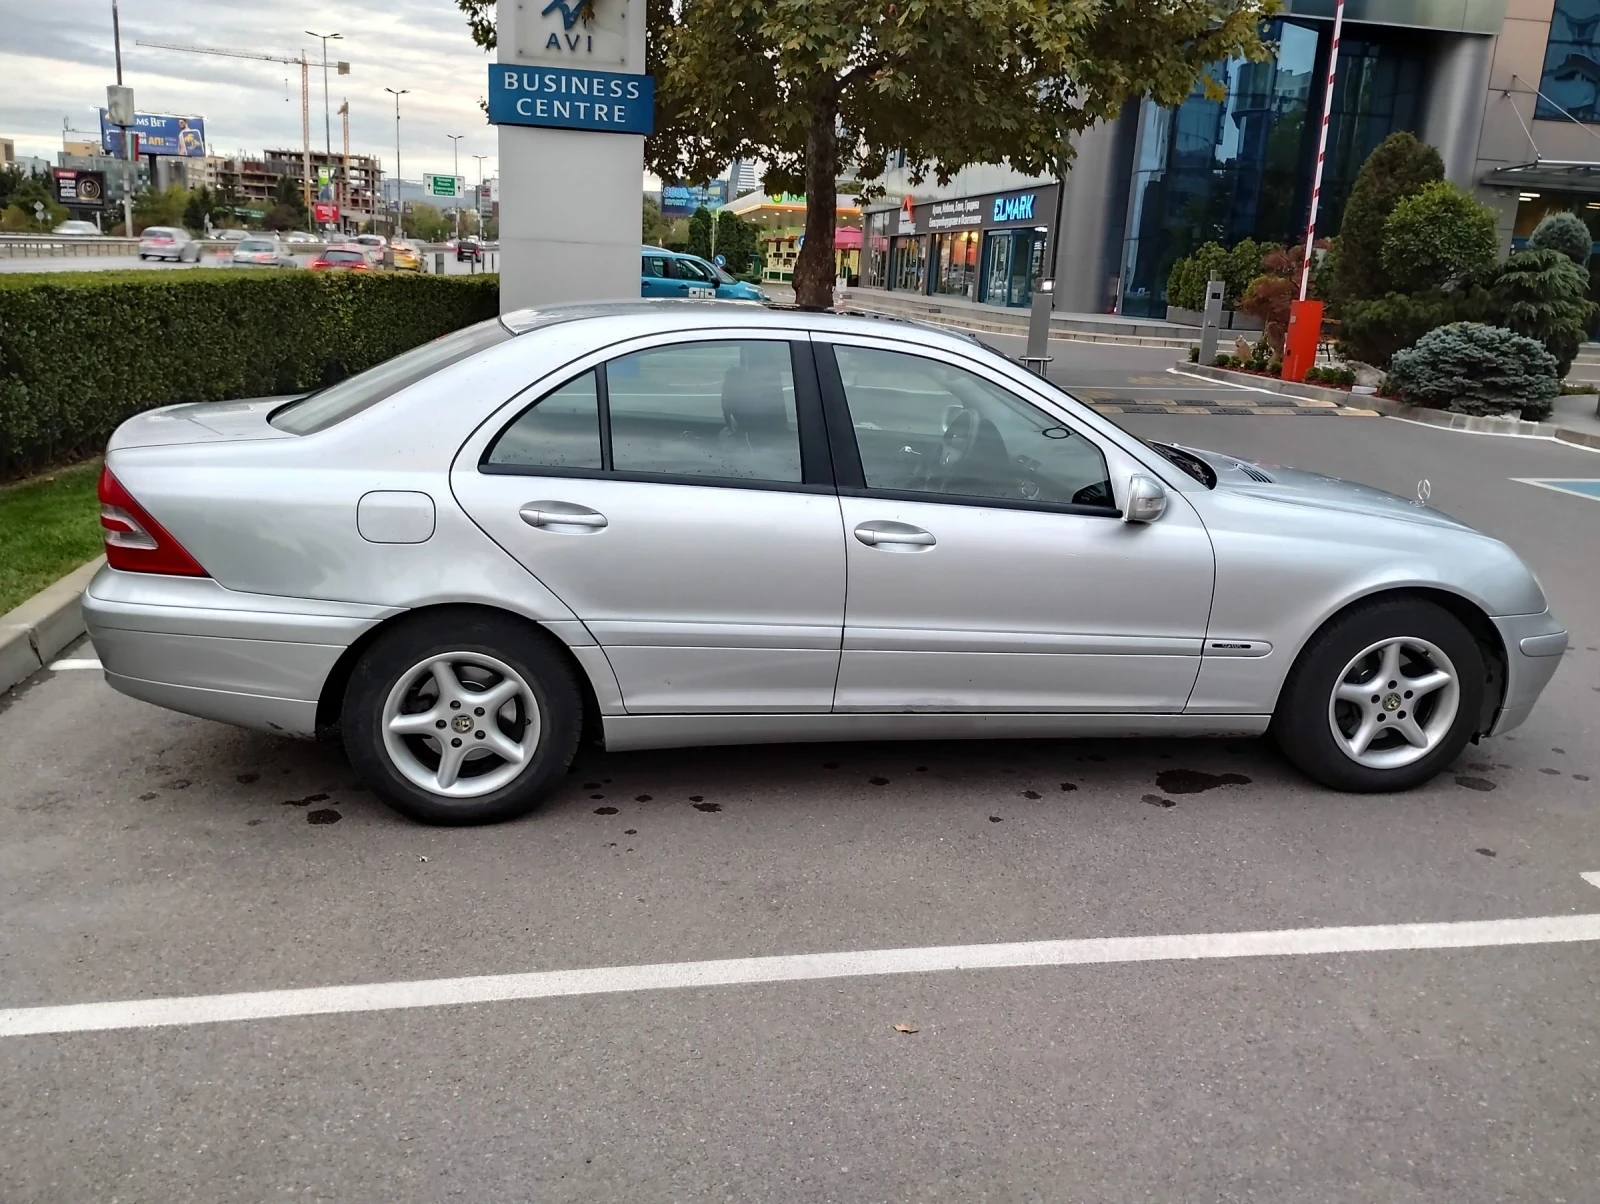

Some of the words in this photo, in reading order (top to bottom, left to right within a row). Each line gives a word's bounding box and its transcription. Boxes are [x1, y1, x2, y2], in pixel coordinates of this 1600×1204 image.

[546, 32, 592, 53] AVI
[504, 71, 639, 99] BUSINESS
[516, 98, 626, 123] CENTRE
[993, 194, 1036, 222] ELMARK
